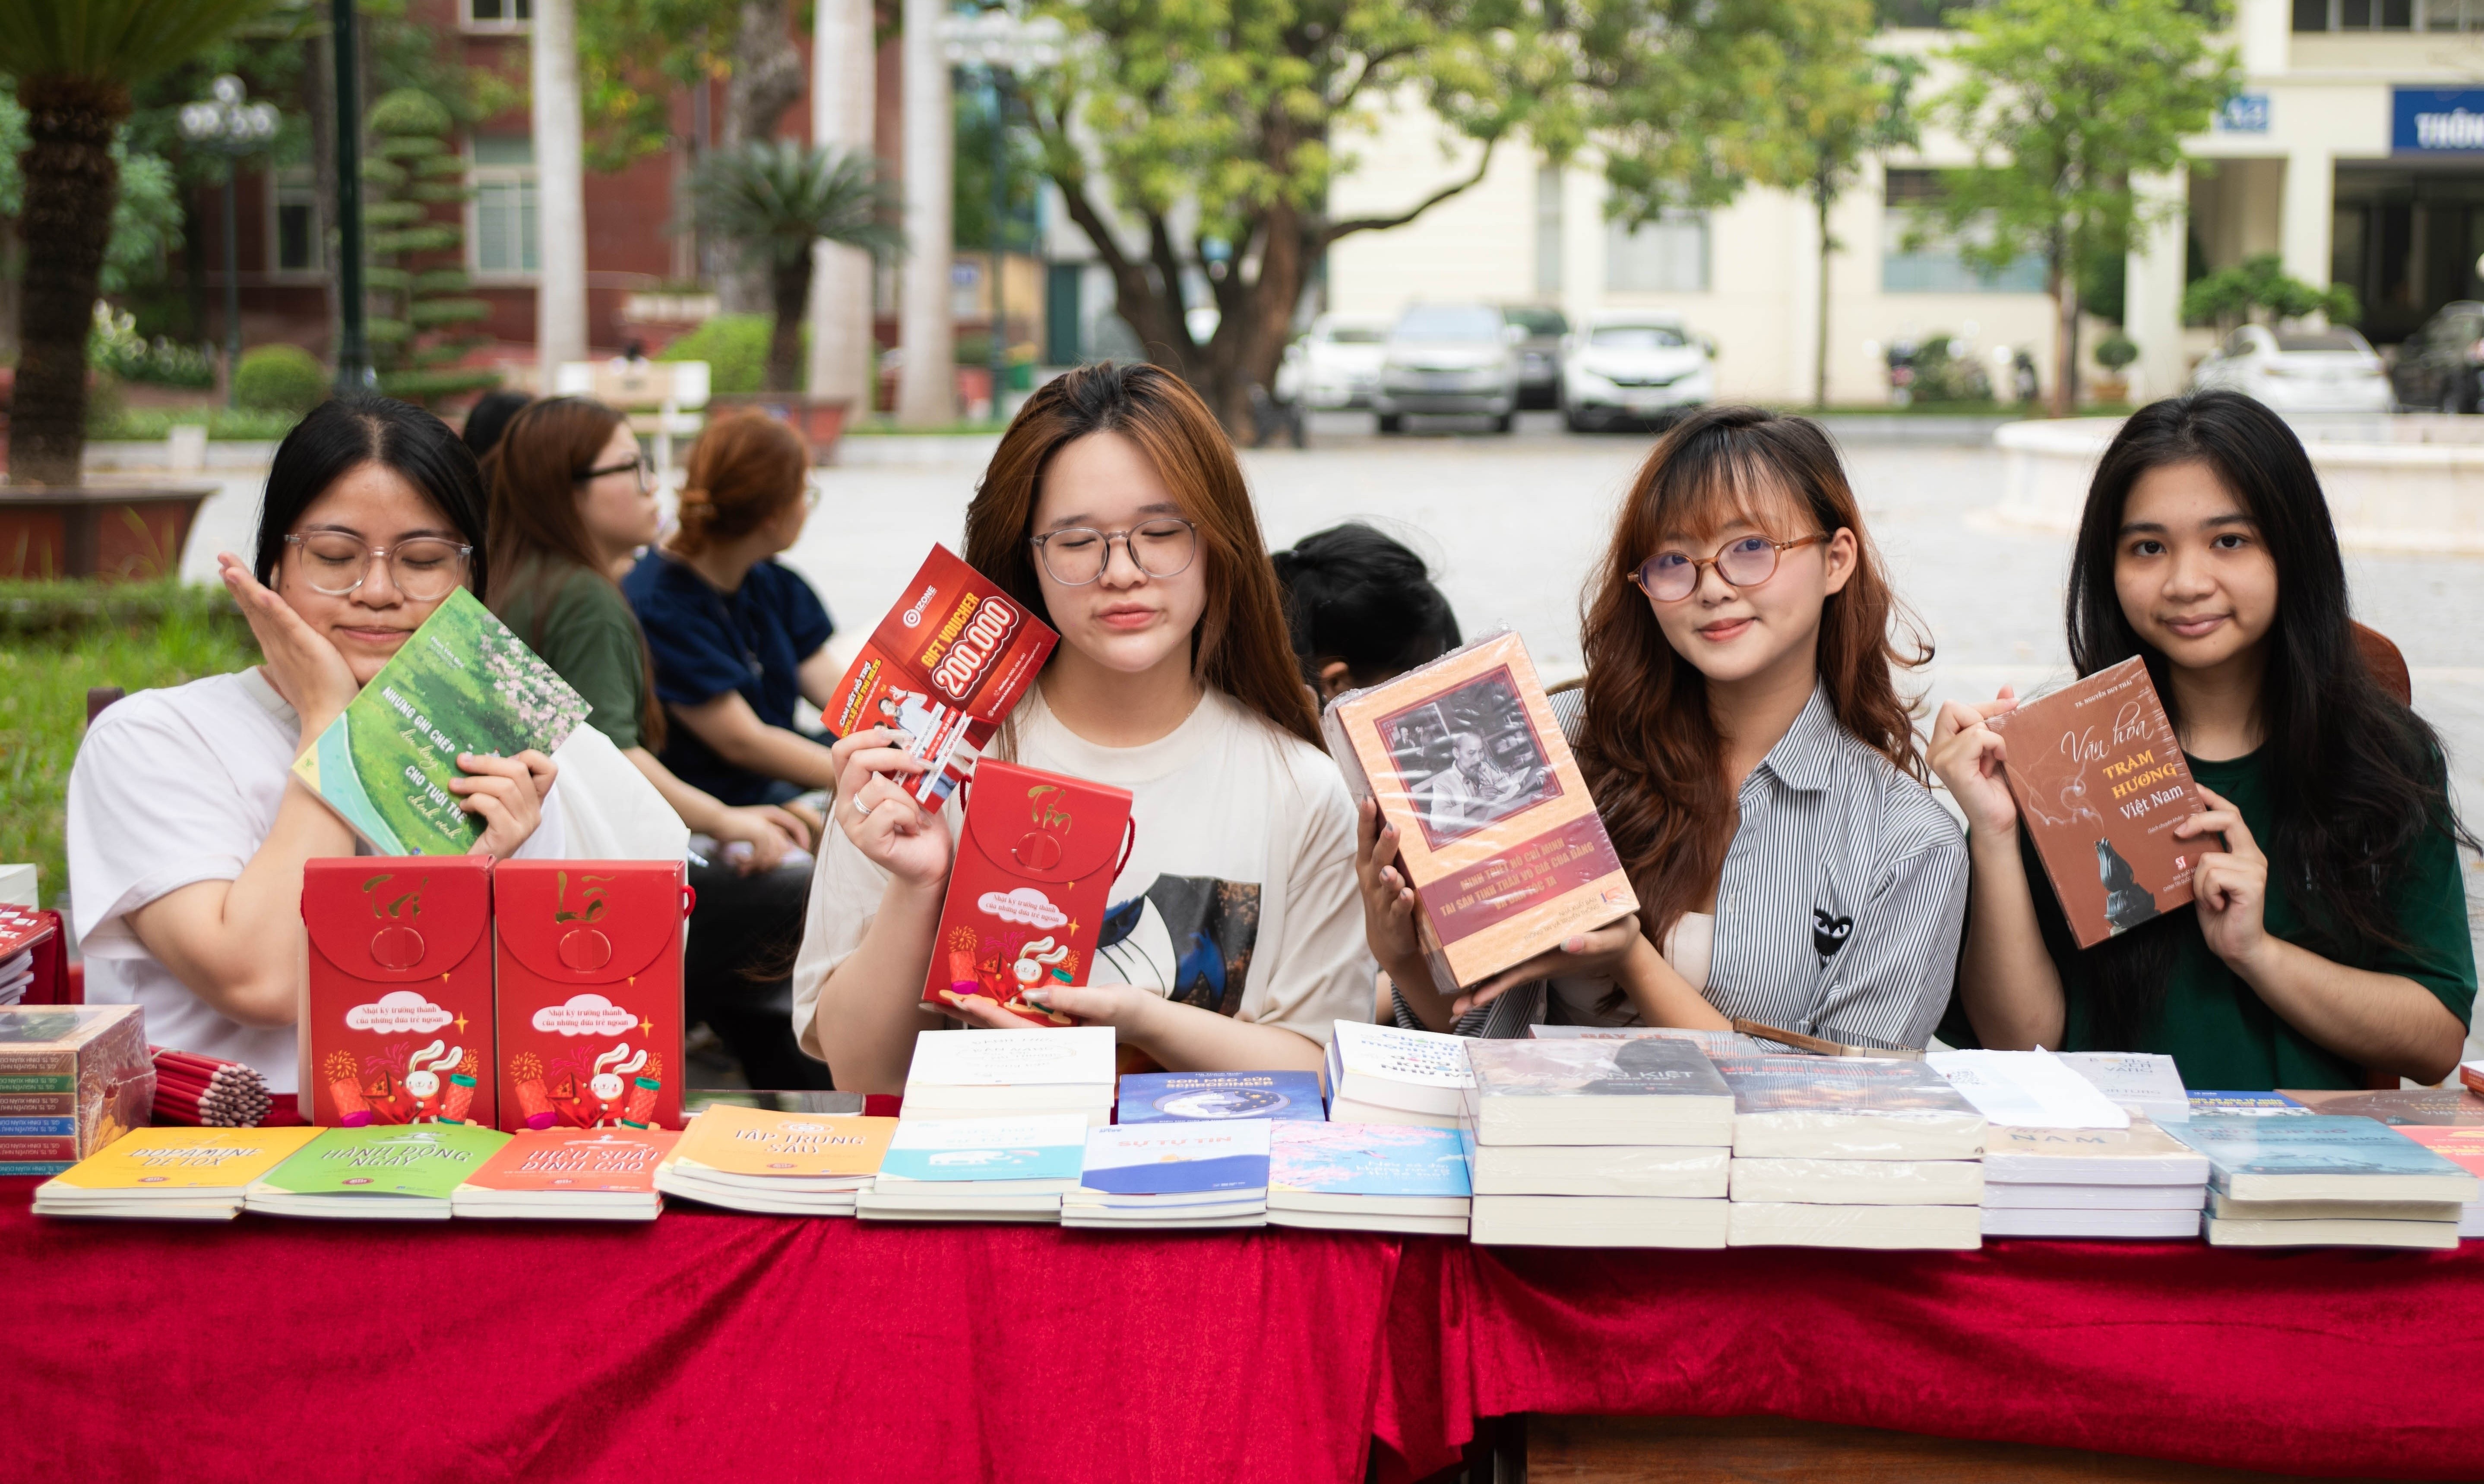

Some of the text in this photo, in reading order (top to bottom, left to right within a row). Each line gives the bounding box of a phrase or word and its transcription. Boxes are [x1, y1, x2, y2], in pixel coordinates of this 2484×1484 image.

[914, 585, 936, 611] IZONE
[921, 639, 946, 668] GIFT
[938, 592, 980, 644] VOUCHER
[936, 601, 1010, 696] 200.000
[839, 660, 871, 726] CAM KẾT HỖ TRỢ
[842, 718, 852, 738] 100%
[849, 707, 857, 720] LỆ
[854, 692, 862, 708] PHÍ
[869, 658, 880, 681] IELTS
[2107, 685, 2118, 694] DUY
[414, 715, 432, 734] GHI
[430, 729, 456, 754] CHÉP
[952, 720, 966, 742] Education
[2060, 701, 2154, 763] Văn hóa
[405, 765, 426, 787] CHO
[2111, 762, 2177, 799] HƯƠNG
[2120, 784, 2184, 820] Việt Nam
[1459, 872, 1485, 891] MINH
[1522, 846, 1541, 863] CHÍ
[1540, 837, 1565, 856] MINH
[1544, 874, 1557, 887] TA
[555, 871, 616, 923] Lễ
[1440, 902, 1456, 917] TÀI
[1475, 884, 1497, 902] TINH
[129, 1147, 264, 1157] DOPAMINE
[786, 1134, 867, 1145] TRUNG
[2010, 1134, 2107, 1144] NAM
[140, 1156, 229, 1166] DETOX
[321, 1146, 396, 1159] HÀNH
[348, 1155, 420, 1166] NGAY
[593, 1161, 644, 1171] CAO
